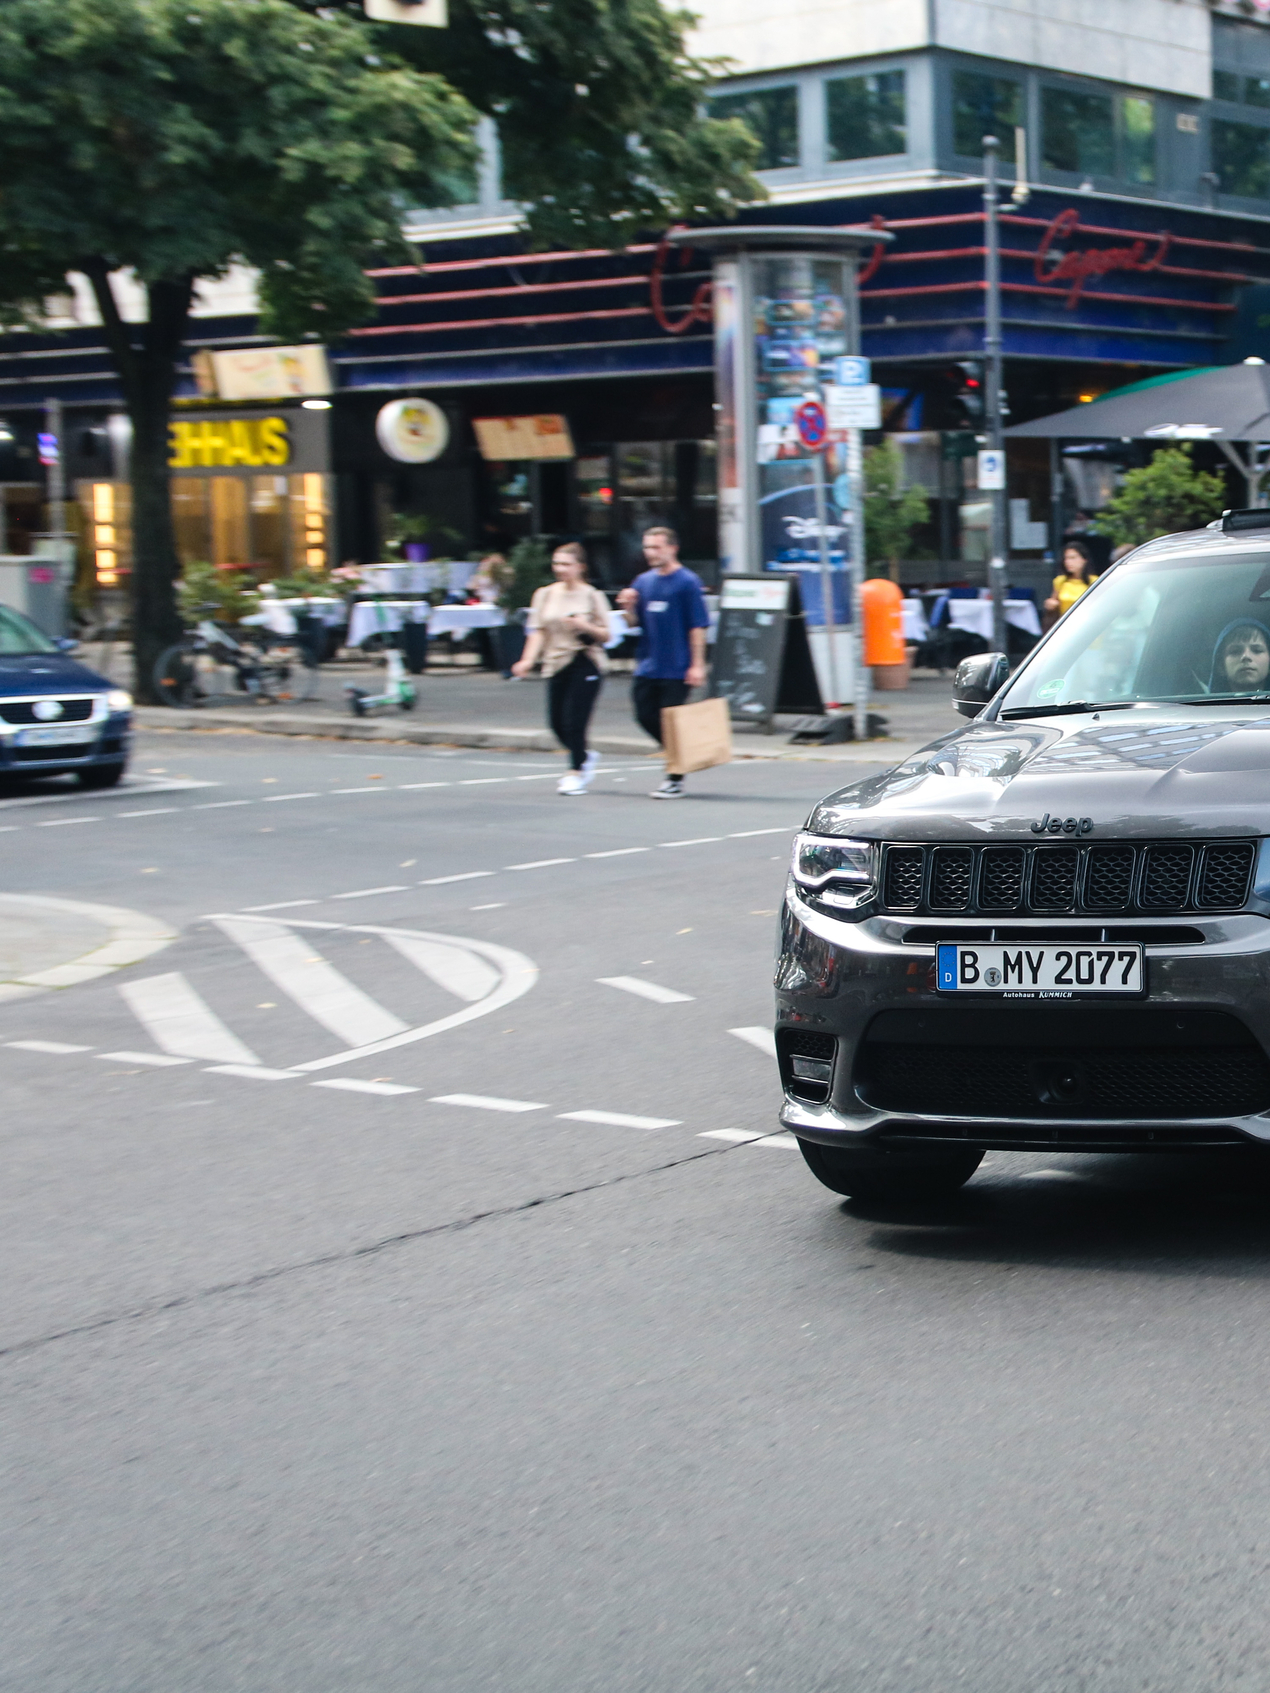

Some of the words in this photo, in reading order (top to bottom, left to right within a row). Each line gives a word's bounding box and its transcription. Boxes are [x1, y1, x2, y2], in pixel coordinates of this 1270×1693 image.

[1031, 813, 1093, 837] Jeep
[944, 972, 953, 983] D
[960, 951, 980, 984] B
[1003, 951, 1044, 985] MY
[1054, 951, 1137, 985] 2077
